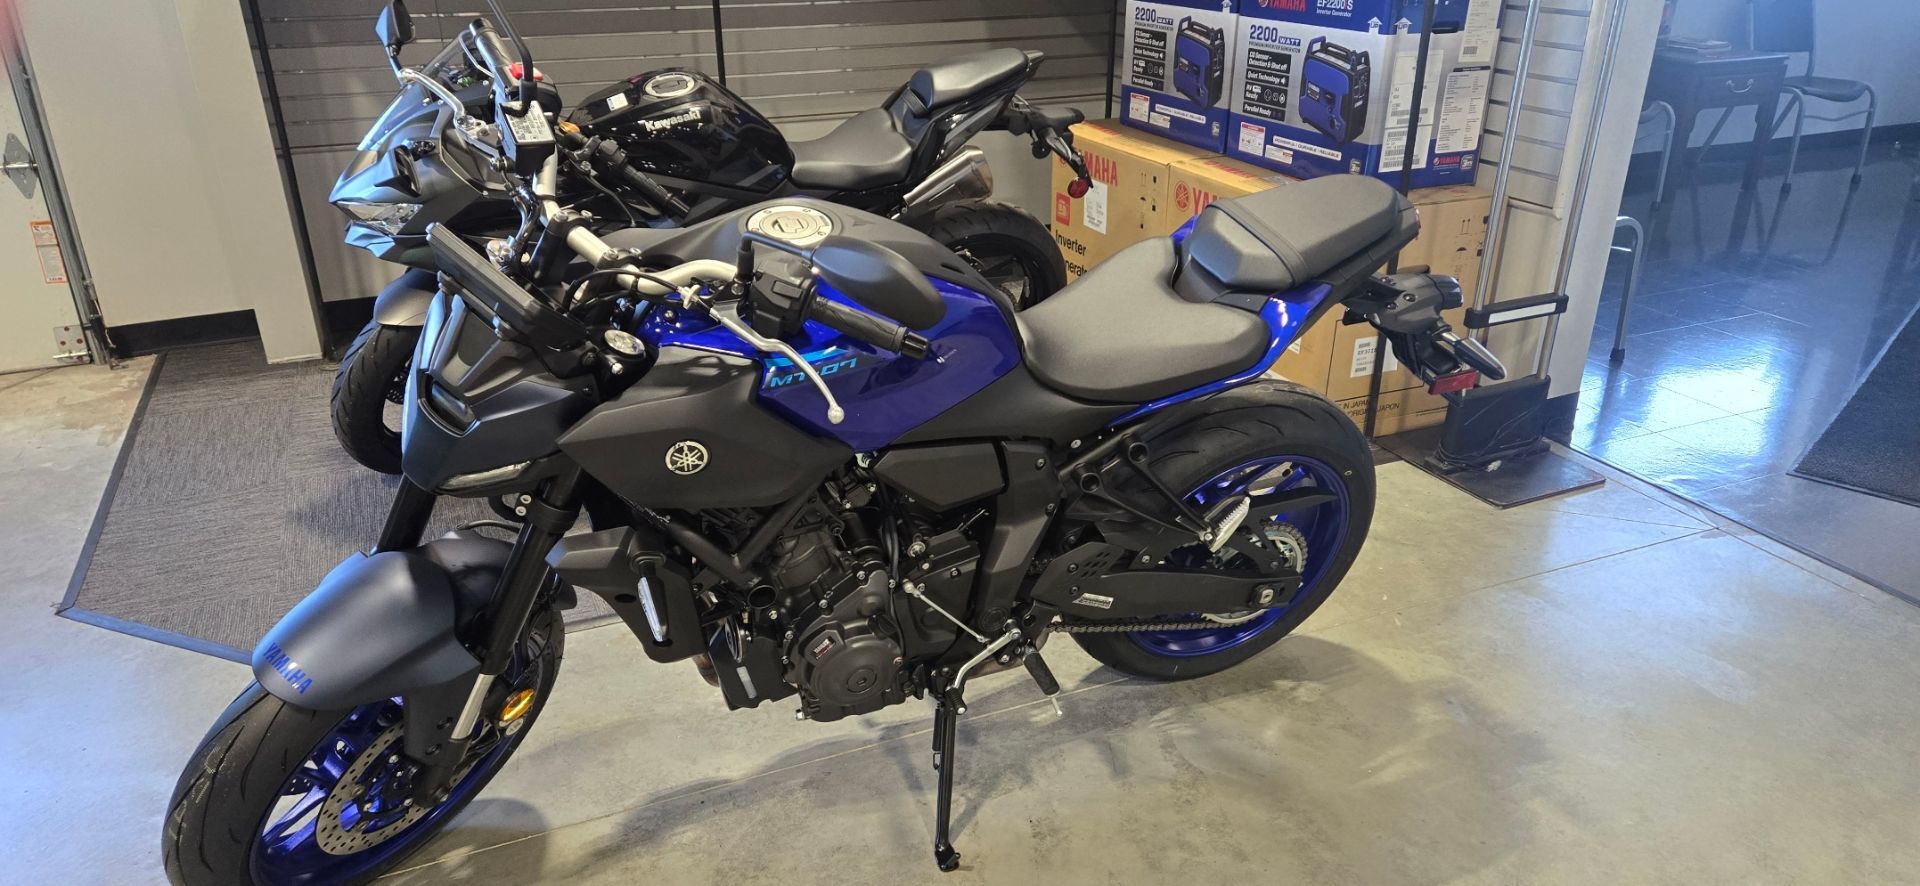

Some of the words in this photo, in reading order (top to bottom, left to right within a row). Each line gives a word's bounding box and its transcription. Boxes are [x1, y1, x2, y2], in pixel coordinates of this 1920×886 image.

[1135, 6, 1156, 23] 2200
[1250, 24, 1278, 42] 2200
[1279, 37, 1300, 46] WATT
[1249, 59, 1267, 67] Detection
[1256, 52, 1269, 60] Sensor
[1259, 73, 1280, 84] Technology
[1246, 91, 1258, 100] Ready
[1244, 104, 1259, 113] Parallel
[1260, 107, 1272, 117] Ready
[644, 107, 701, 132] Kawasaki
[1084, 150, 1118, 187] MAHA
[1055, 229, 1087, 256] Inverter
[1066, 260, 1088, 277] nerat
[770, 358, 857, 387] MT-07
[264, 642, 312, 694] YAMAHA
